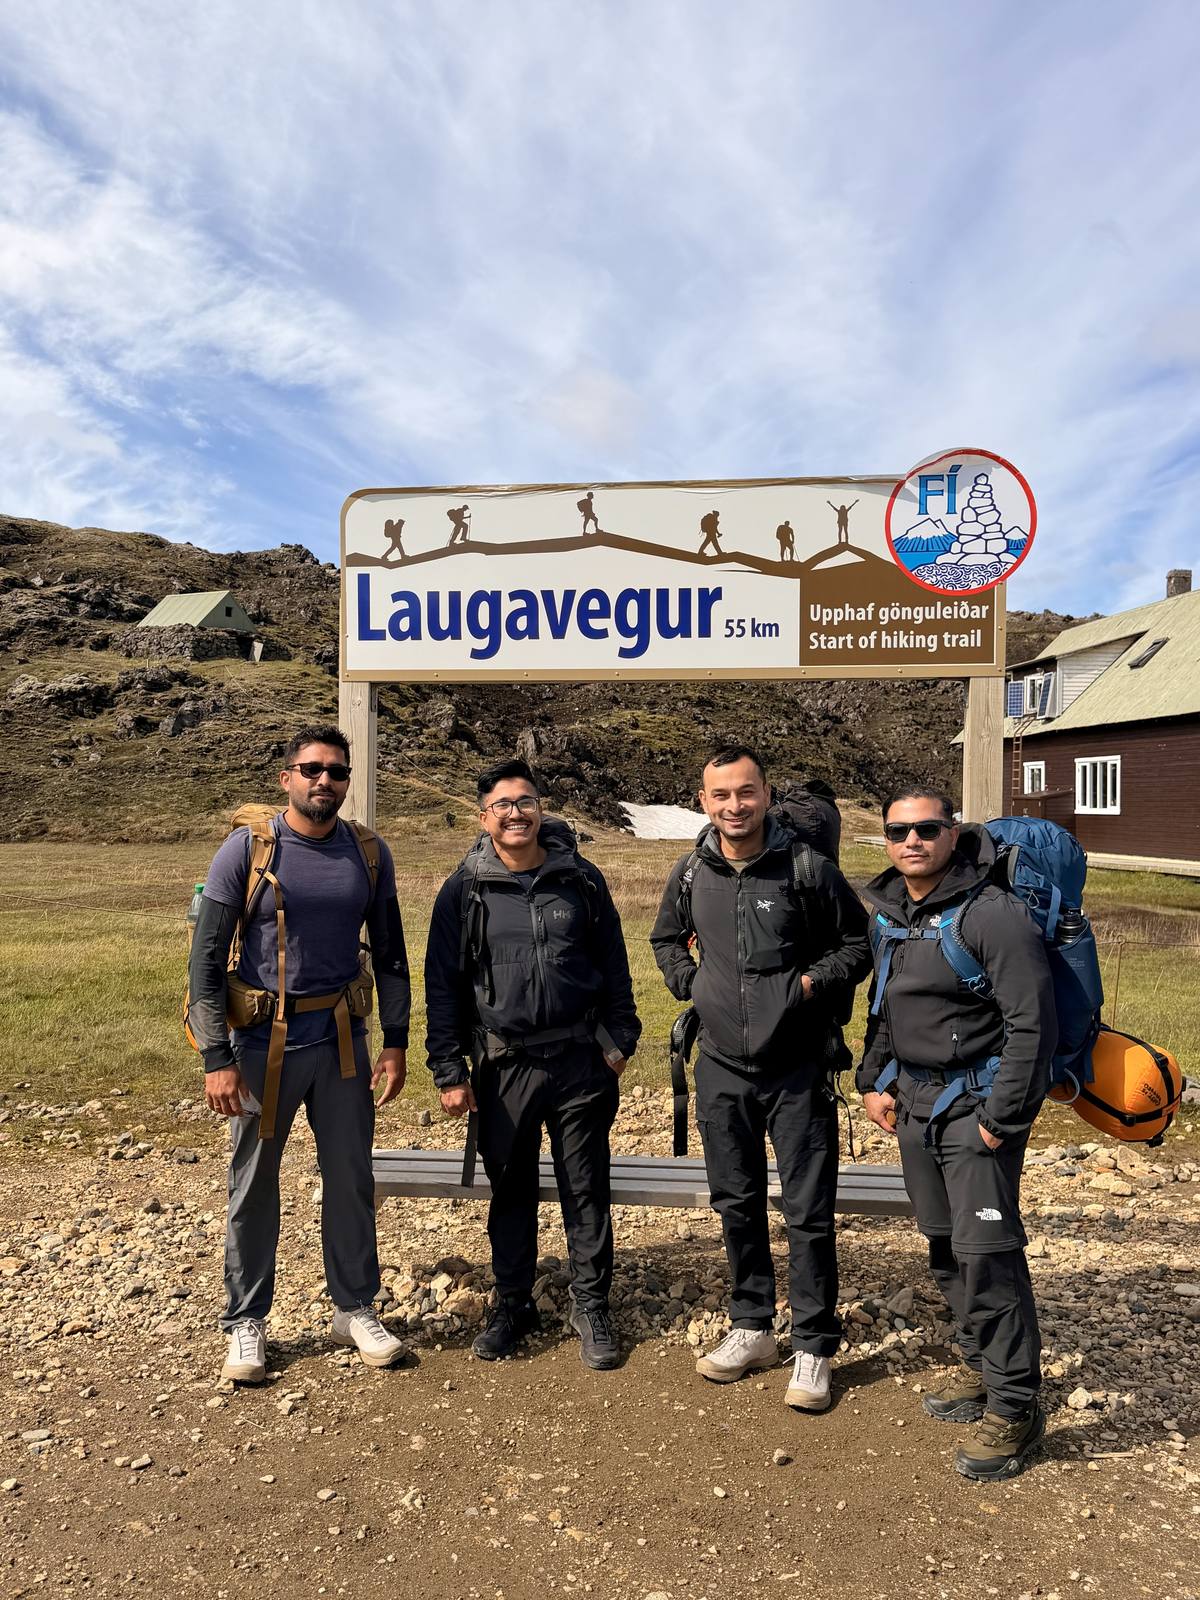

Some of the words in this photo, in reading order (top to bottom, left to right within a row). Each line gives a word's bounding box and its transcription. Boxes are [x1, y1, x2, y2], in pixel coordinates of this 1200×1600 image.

[917, 464, 962, 516] FÍ
[357, 573, 723, 660] Laugavegur
[724, 618, 746, 638] 55
[751, 617, 780, 637] km
[809, 603, 875, 625] Upphaf
[879, 601, 989, 625] gönguleiðar
[809, 632, 853, 650] Start
[858, 630, 877, 649] of
[881, 630, 937, 652] hiking
[942, 629, 981, 648] trail
